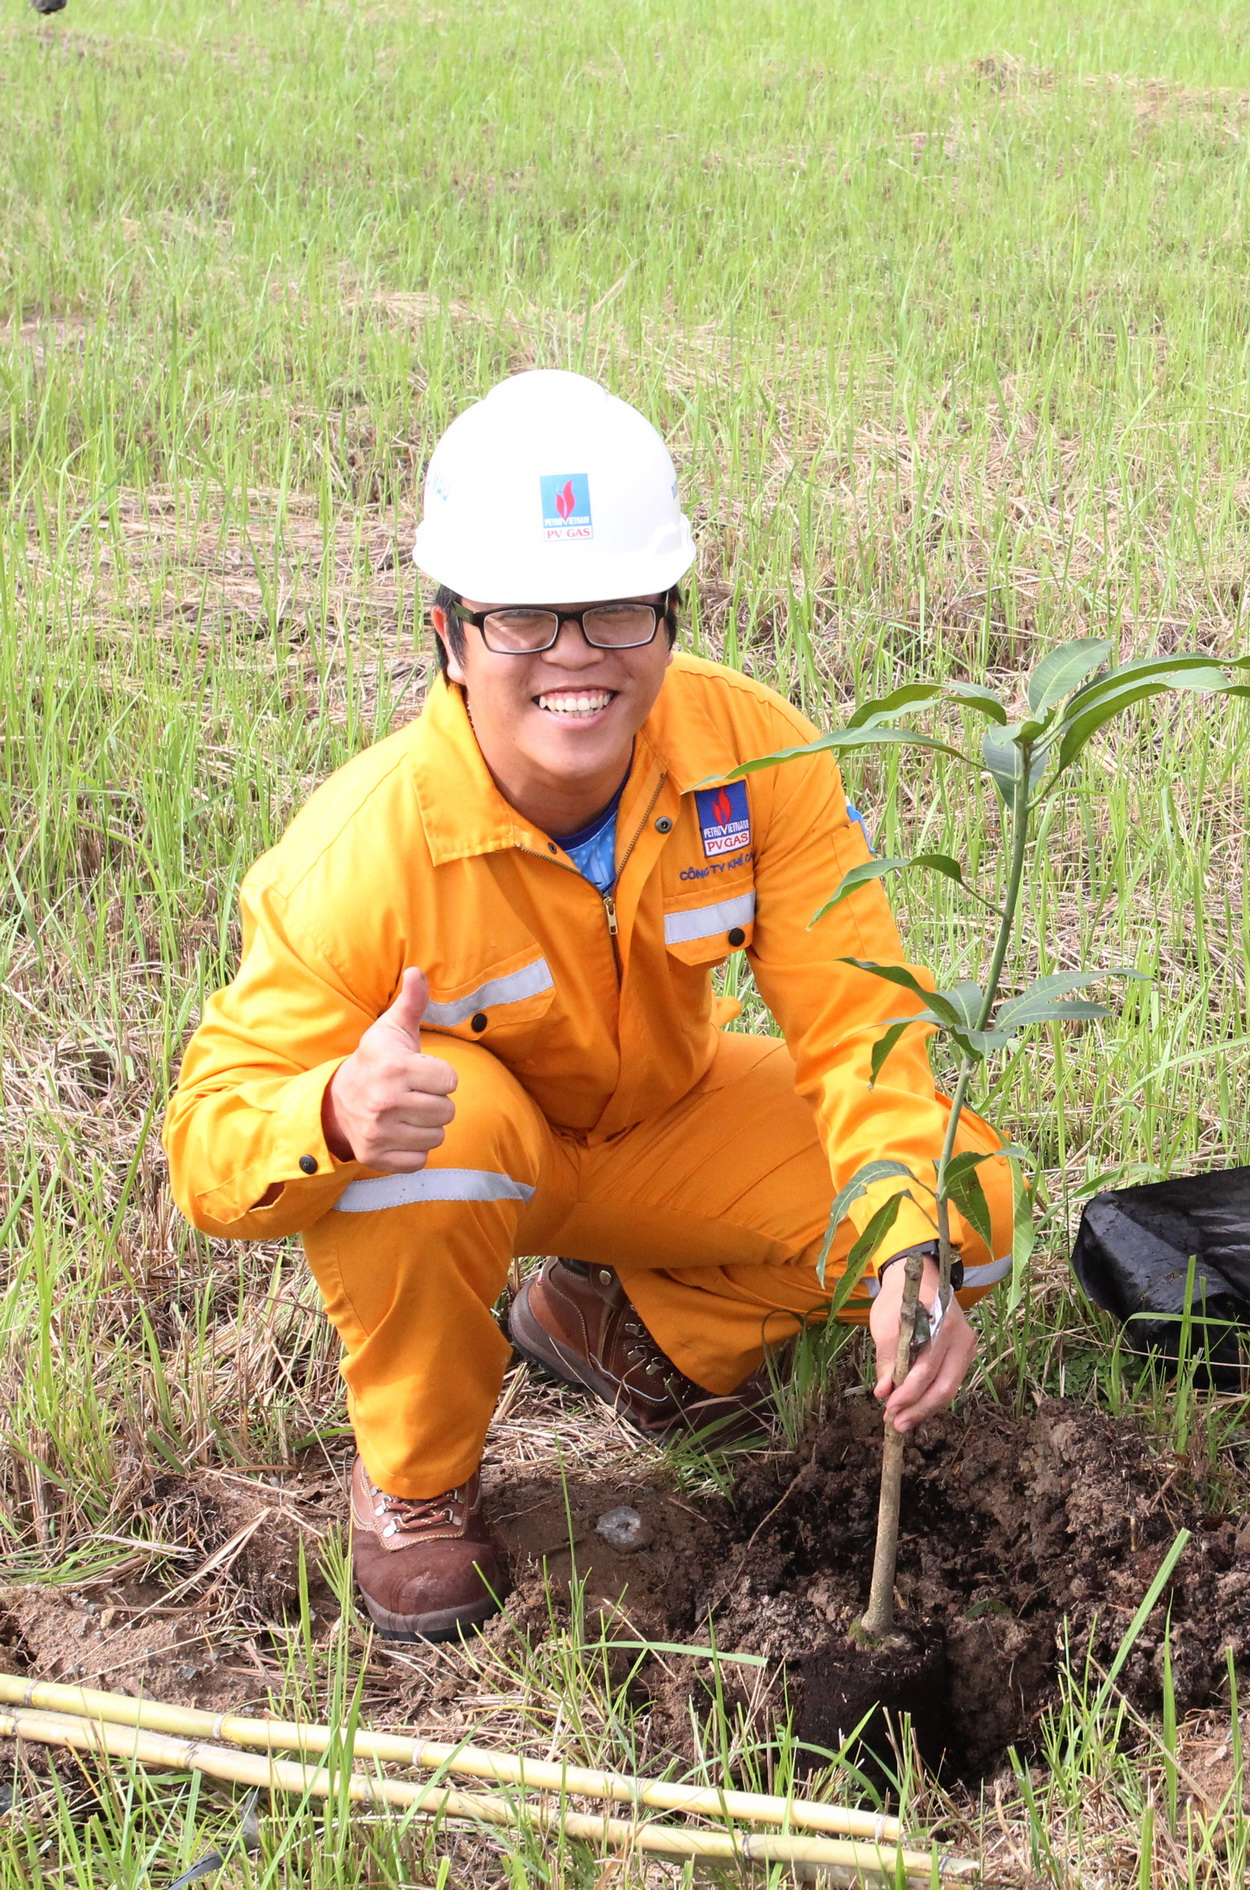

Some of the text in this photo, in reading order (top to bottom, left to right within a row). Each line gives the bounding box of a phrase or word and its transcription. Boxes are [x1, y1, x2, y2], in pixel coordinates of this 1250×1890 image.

[547, 527, 591, 539] PV GAS
[703, 819, 749, 839] PETROVIETNAM
[707, 832, 749, 853] PV GAS
[679, 866, 709, 881] CÔNG
[710, 863, 725, 873] TY
